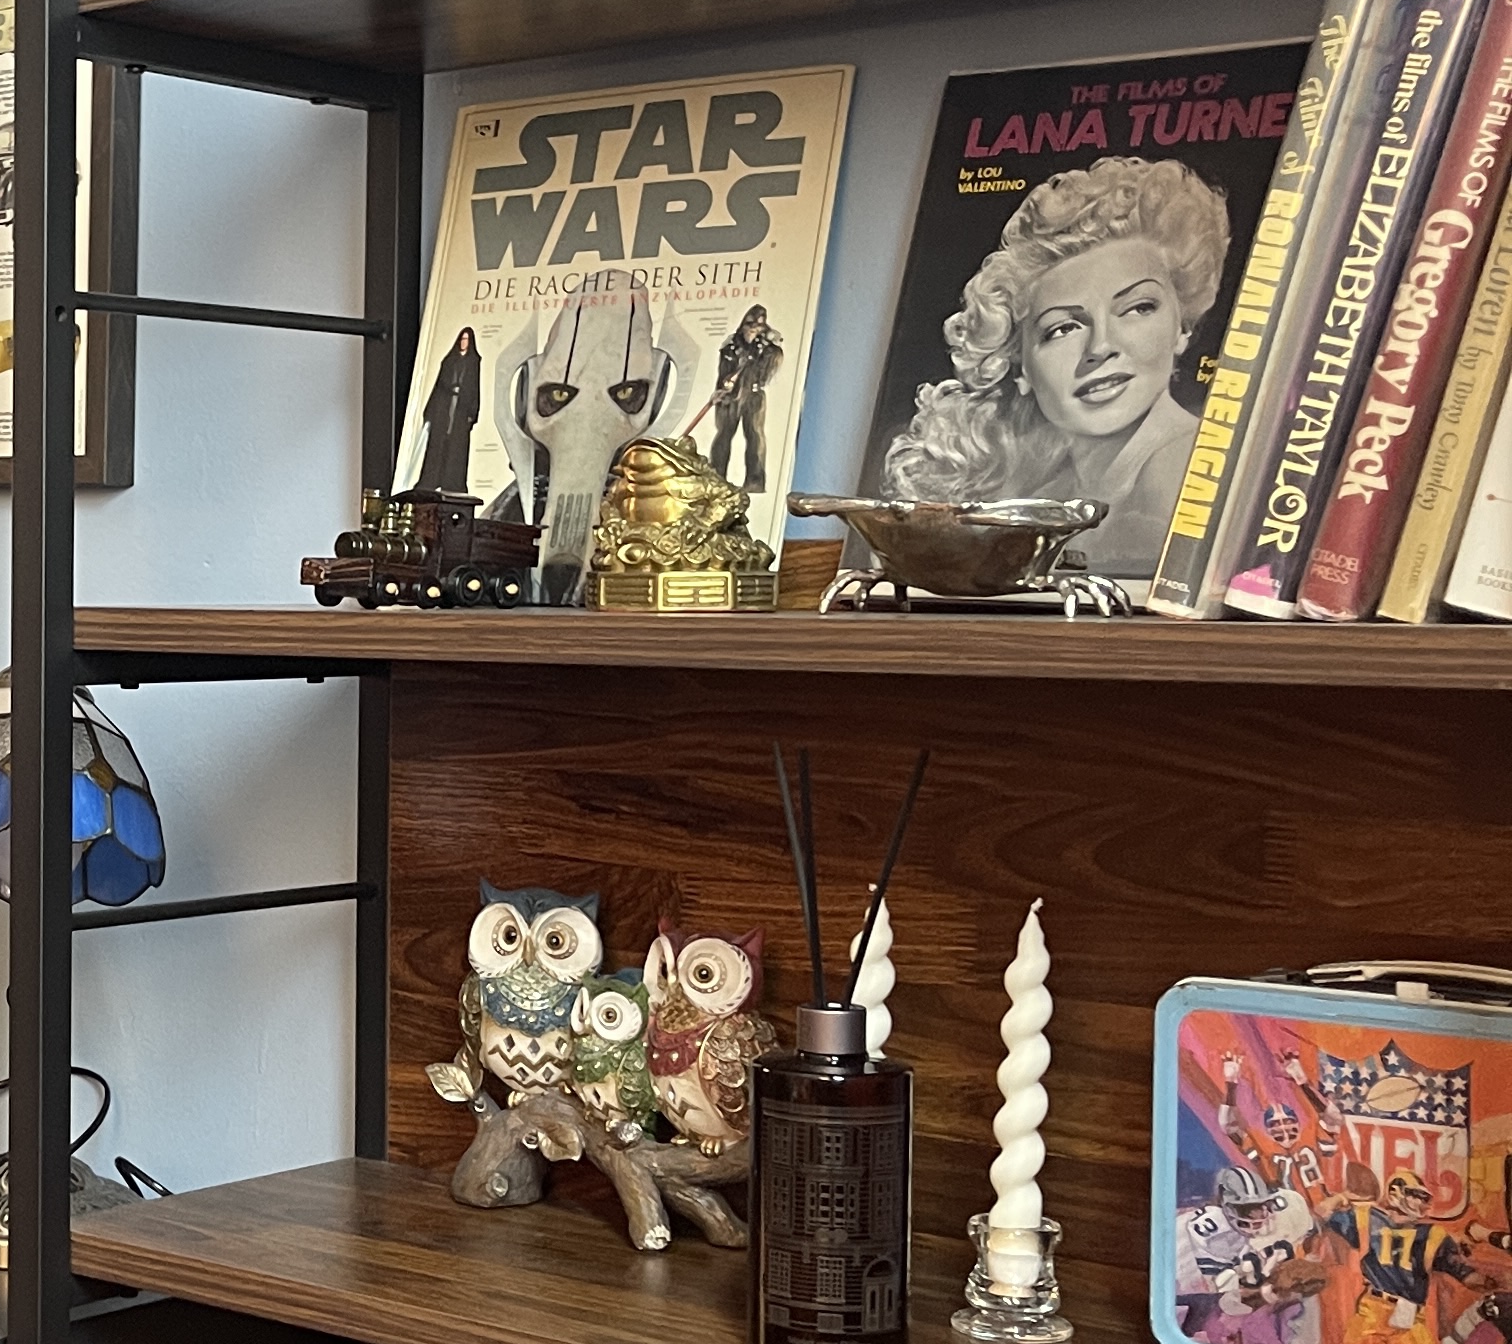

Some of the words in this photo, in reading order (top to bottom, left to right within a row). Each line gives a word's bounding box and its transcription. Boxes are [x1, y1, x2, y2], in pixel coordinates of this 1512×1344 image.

[1411, 9, 1443, 49] the
[1071, 85, 1110, 104] THE
[1117, 77, 1187, 102] FILMS
[1193, 74, 1228, 93] OF
[1392, 53, 1432, 113] films
[472, 91, 804, 194] STAR
[963, 108, 1108, 158] LANA
[1382, 116, 1407, 144] of
[1469, 101, 1511, 169] FILMS
[957, 179, 1026, 193] VALENTINO
[959, 169, 973, 180] by
[977, 167, 1002, 178] LOU
[1281, 151, 1315, 175] of
[1458, 171, 1488, 208] OF
[471, 171, 800, 271] WARS
[474, 277, 516, 300] DIE
[528, 269, 617, 296] RACHE
[629, 266, 683, 290] DER
[695, 261, 763, 285] SITH
[1224, 189, 1303, 361] RONALD
[1307, 145, 1413, 387] ELIZABETH
[471, 303, 495, 314] DIE
[1373, 209, 1473, 394] Gregory
[1459, 346, 1493, 370] by
[1173, 368, 1250, 539] REAGAN
[1257, 388, 1341, 553] TAYLOR
[1338, 396, 1416, 504] Peck
[1417, 431, 1459, 512] Crawley
[1274, 1147, 1323, 1188] 72
